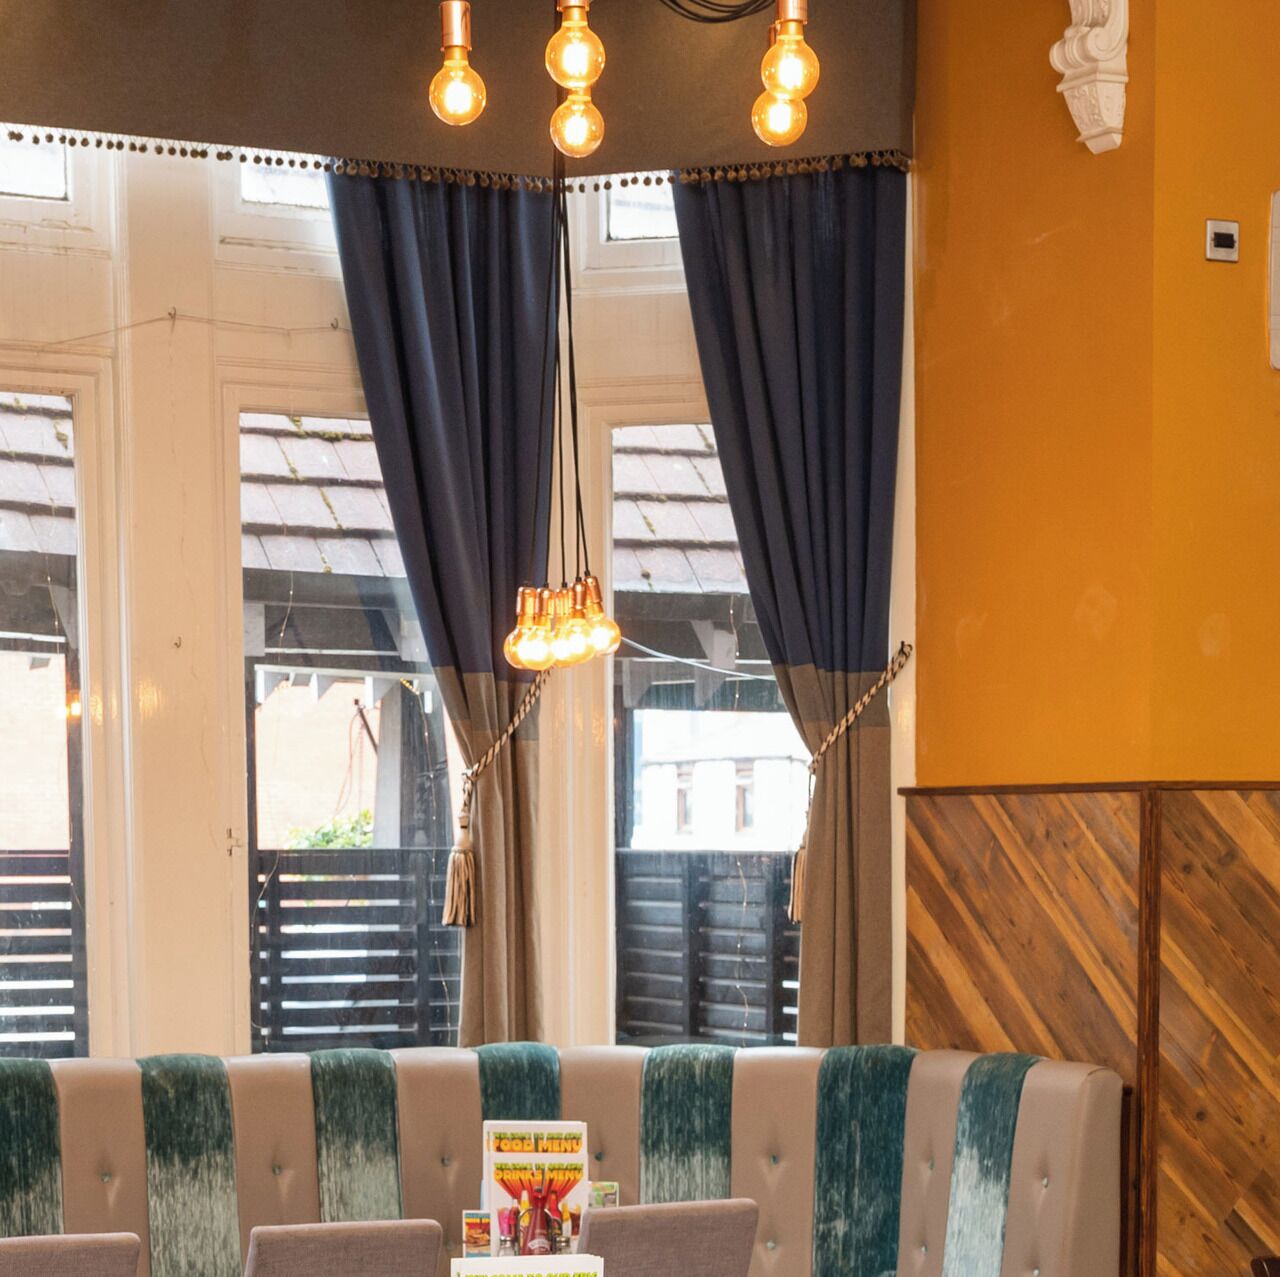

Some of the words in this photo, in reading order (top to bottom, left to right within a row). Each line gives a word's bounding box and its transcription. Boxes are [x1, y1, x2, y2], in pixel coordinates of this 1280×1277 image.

[493, 1139, 533, 1152] FOOD
[539, 1139, 582, 1152] MENU
[494, 1170, 542, 1180] DRINKS
[546, 1170, 583, 1180] MENU
